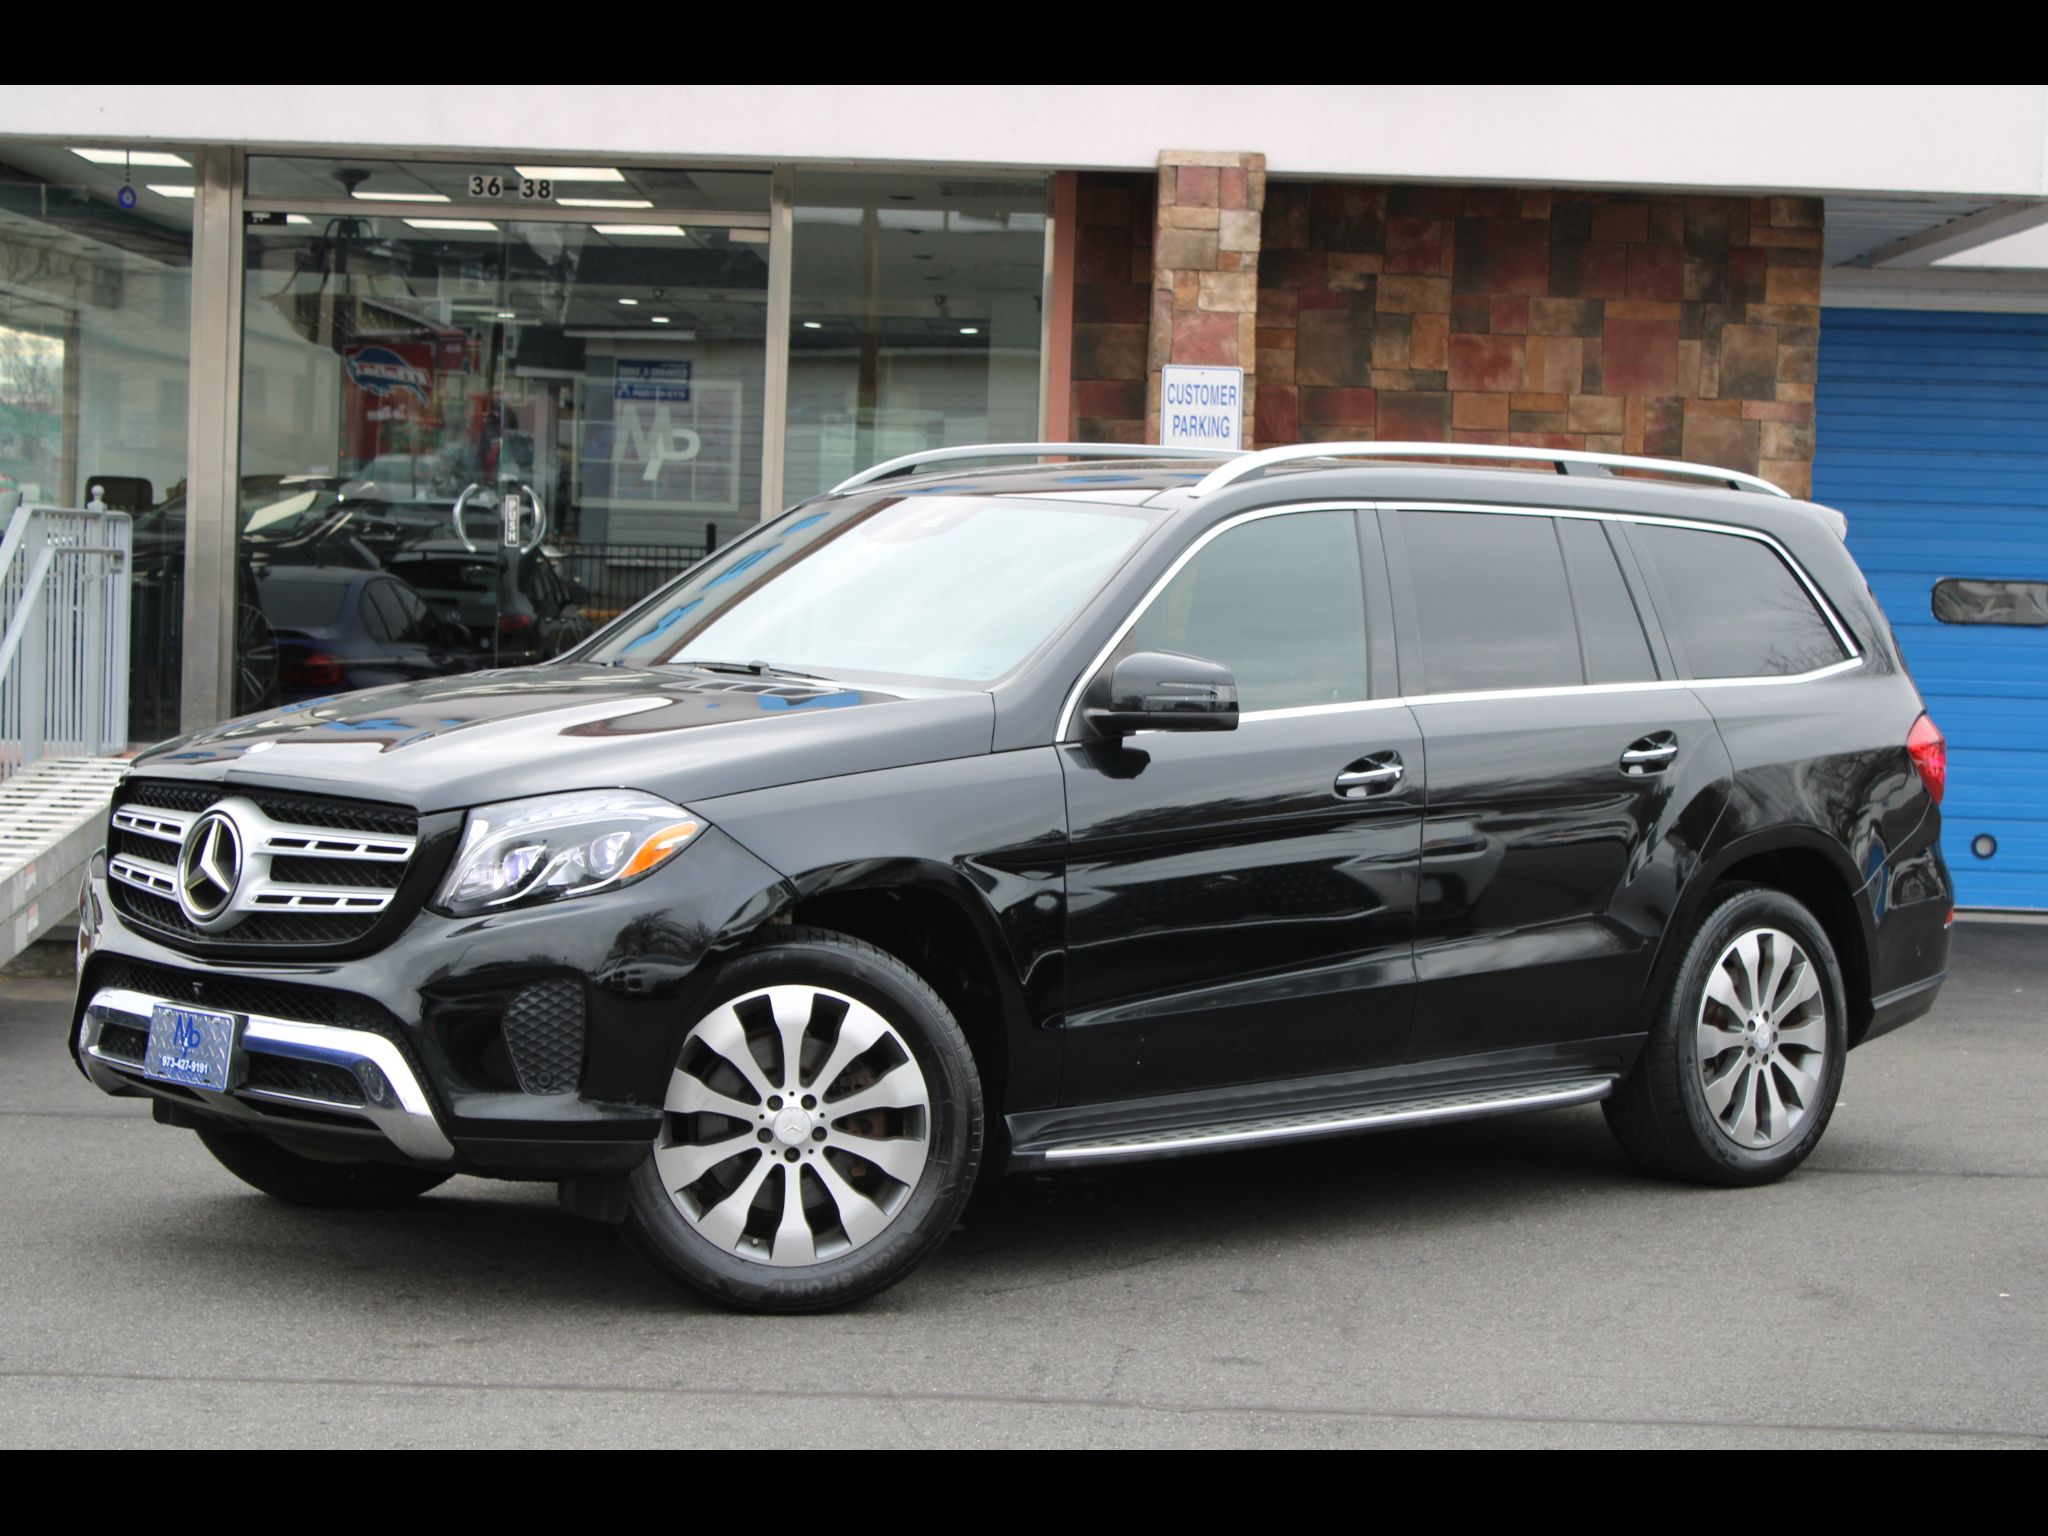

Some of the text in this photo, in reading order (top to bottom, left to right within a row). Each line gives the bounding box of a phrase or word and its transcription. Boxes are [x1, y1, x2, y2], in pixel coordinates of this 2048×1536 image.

[1167, 383, 1237, 406] CUSTOMER
[1172, 414, 1230, 438] PARKING
[508, 500, 517, 542] PUSH
[162, 1055, 208, 1075] 973-427-9191
